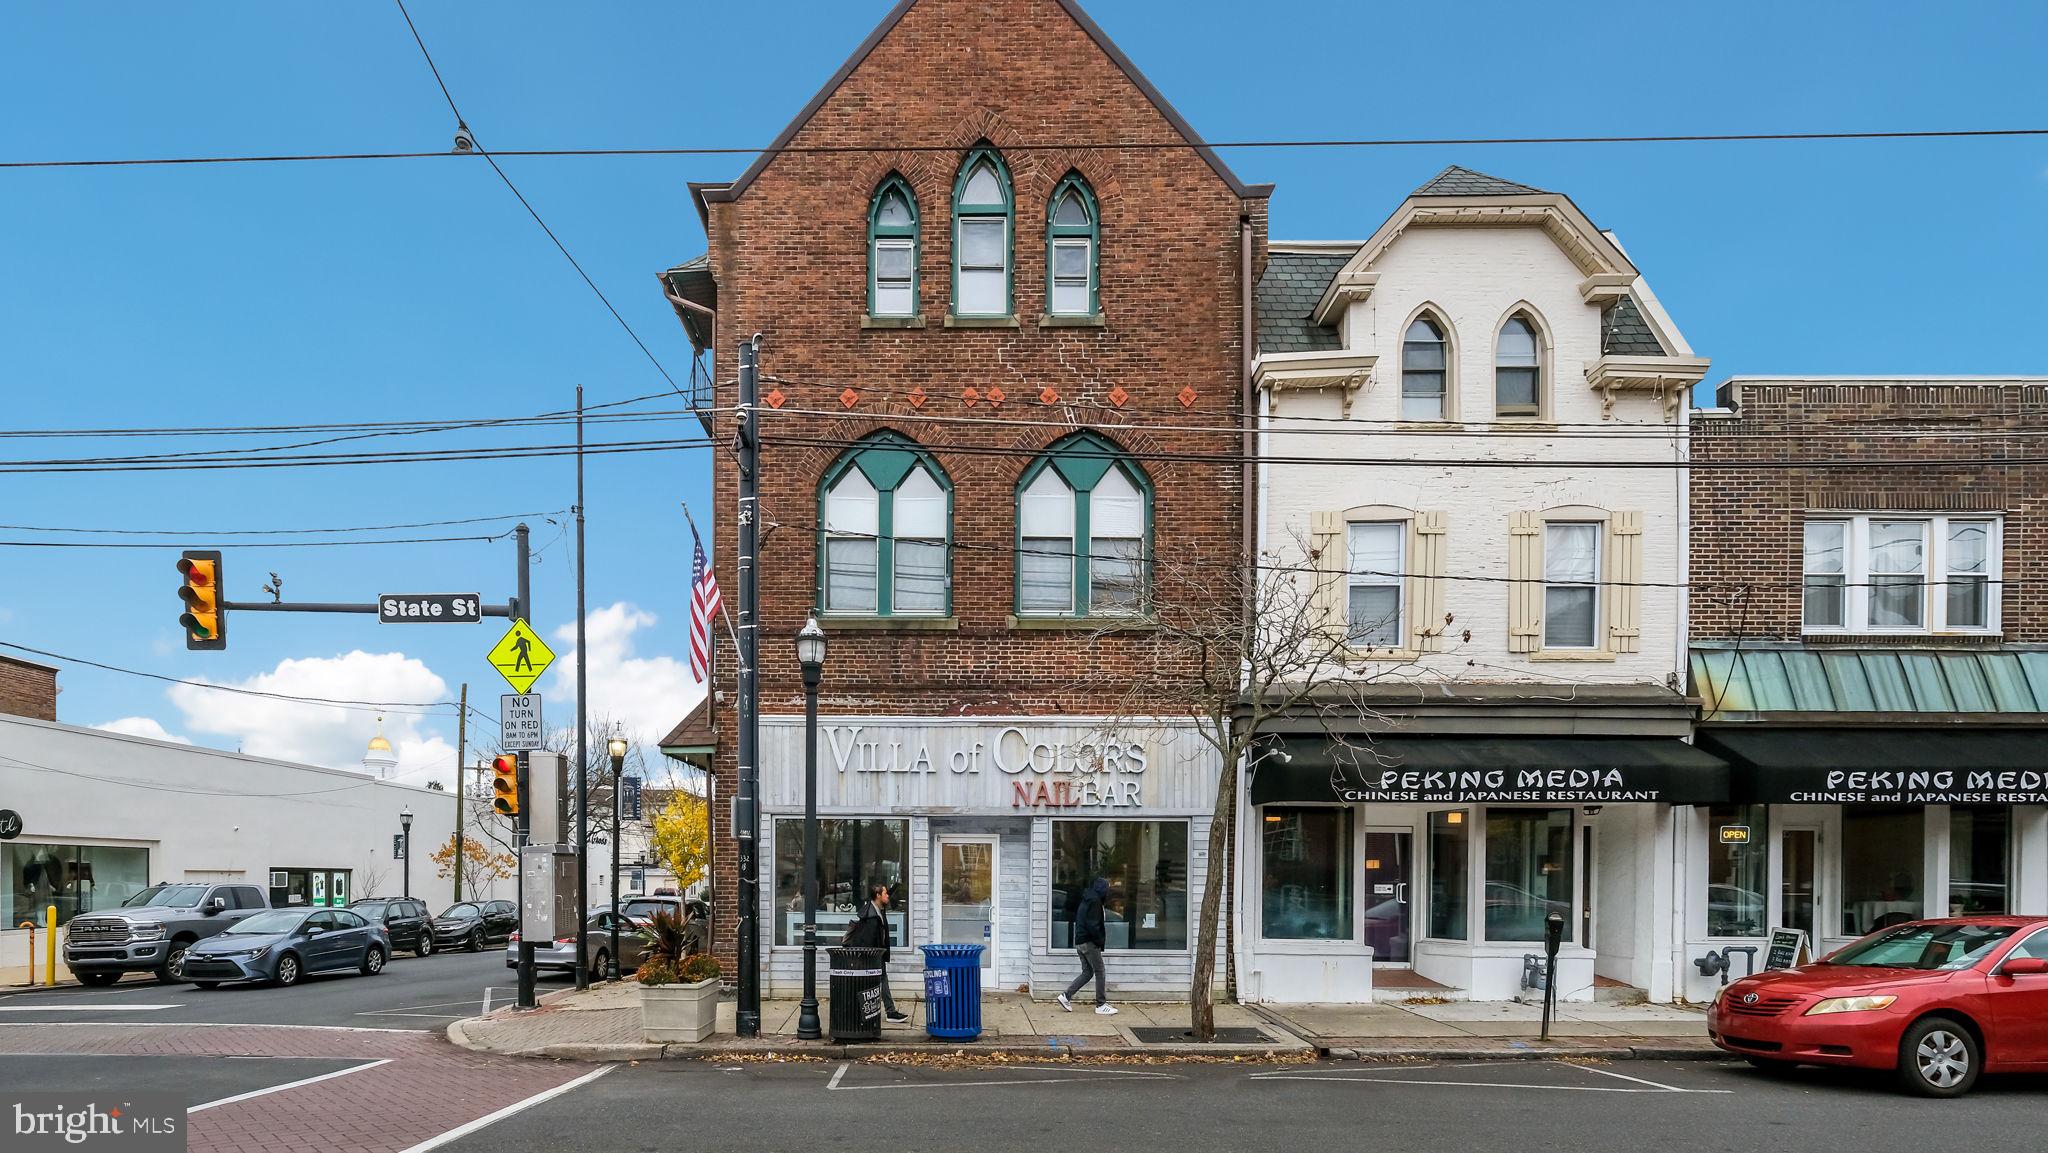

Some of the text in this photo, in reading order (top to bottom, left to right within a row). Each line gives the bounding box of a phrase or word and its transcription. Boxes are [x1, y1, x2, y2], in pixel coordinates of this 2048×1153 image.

[383, 598, 476, 617] State St
[512, 697, 530, 708] NO
[510, 709, 534, 719] TURN
[504, 720, 539, 730] ON RED
[505, 731, 539, 739] 8AM TO 6PM
[521, 740, 540, 748] SUNDAY
[949, 742, 984, 774] of
[1380, 768, 1623, 790] PEKING MEDIA
[1826, 770, 1954, 790] PEKING
[1344, 790, 1660, 802] CHINESE and JAPANESE RESTAURANT
[1789, 791, 2048, 803] CHINESE and JAPANESE RESTA
[1722, 830, 1747, 839] OPEN
[861, 987, 880, 1002] TRASH
